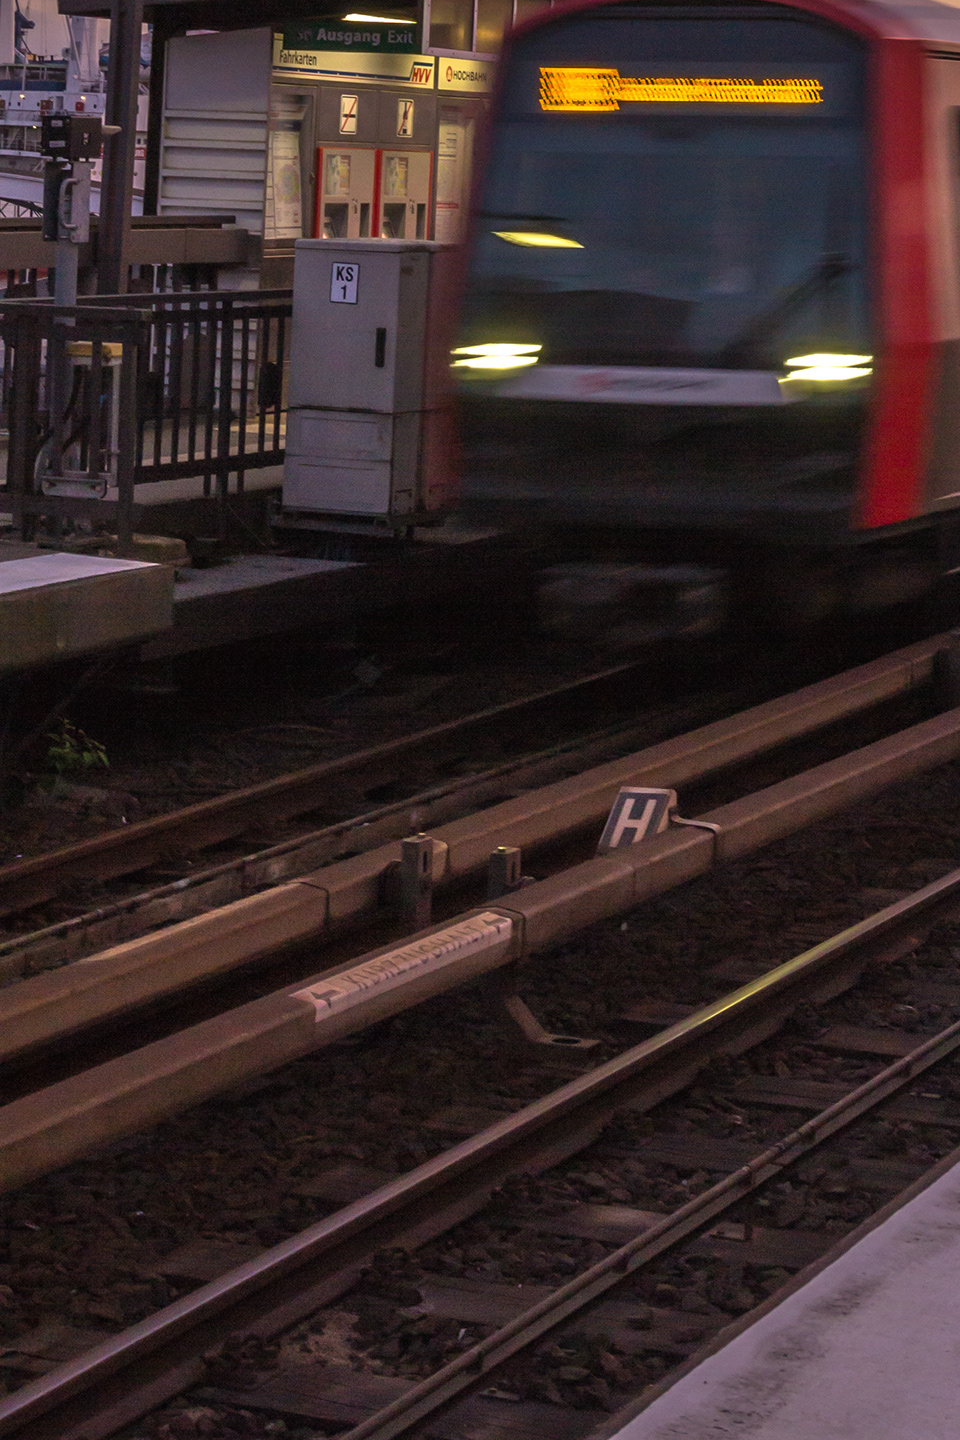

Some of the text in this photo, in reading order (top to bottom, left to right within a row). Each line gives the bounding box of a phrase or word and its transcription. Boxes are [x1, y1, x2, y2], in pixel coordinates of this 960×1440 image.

[316, 27, 414, 47] Ausgang Exit
[279, 49, 317, 66] Fahrkarten
[411, 67, 432, 83] HVV
[453, 69, 487, 83] HOCHBAHN
[336, 265, 355, 282] KS
[340, 284, 347, 300] 1
[608, 798, 658, 848] H
